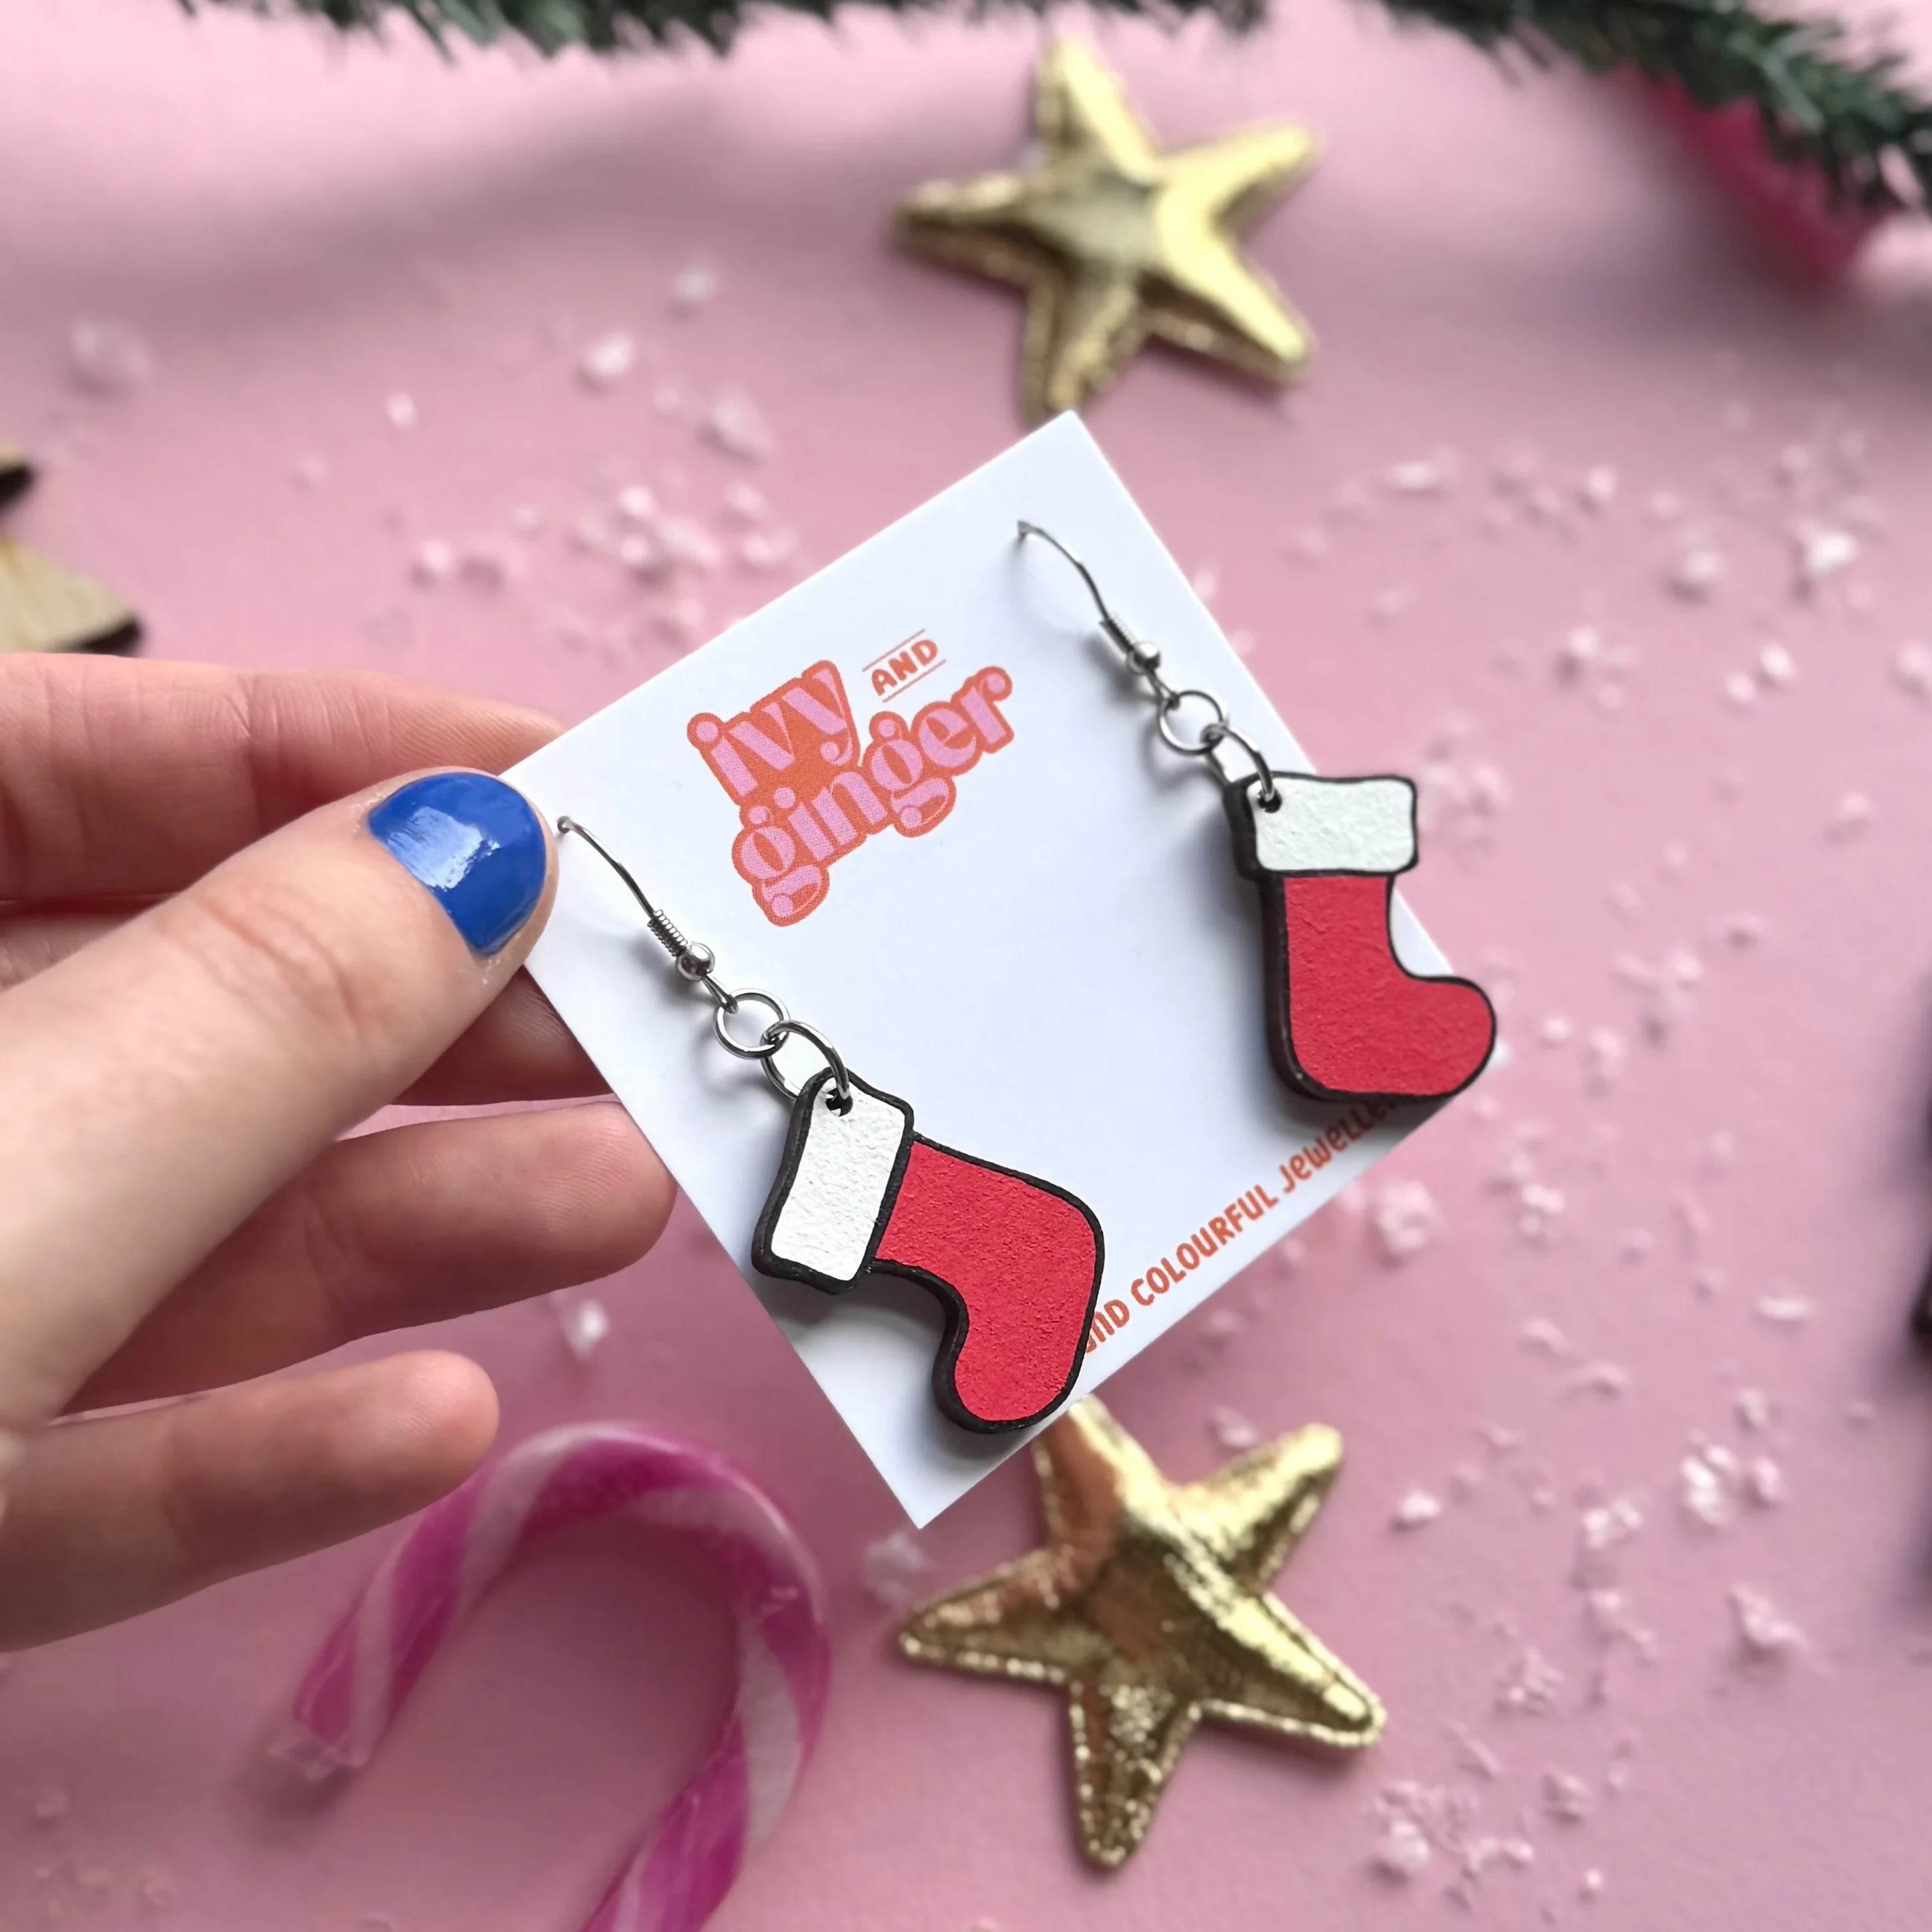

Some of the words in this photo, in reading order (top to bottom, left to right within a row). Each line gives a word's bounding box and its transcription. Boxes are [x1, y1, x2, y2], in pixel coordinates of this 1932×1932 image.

[687, 660, 860, 805] ivy
[871, 639, 939, 696] AND
[731, 666, 1014, 927] ginger
[1130, 1184, 1279, 1306] COLOURFUL
